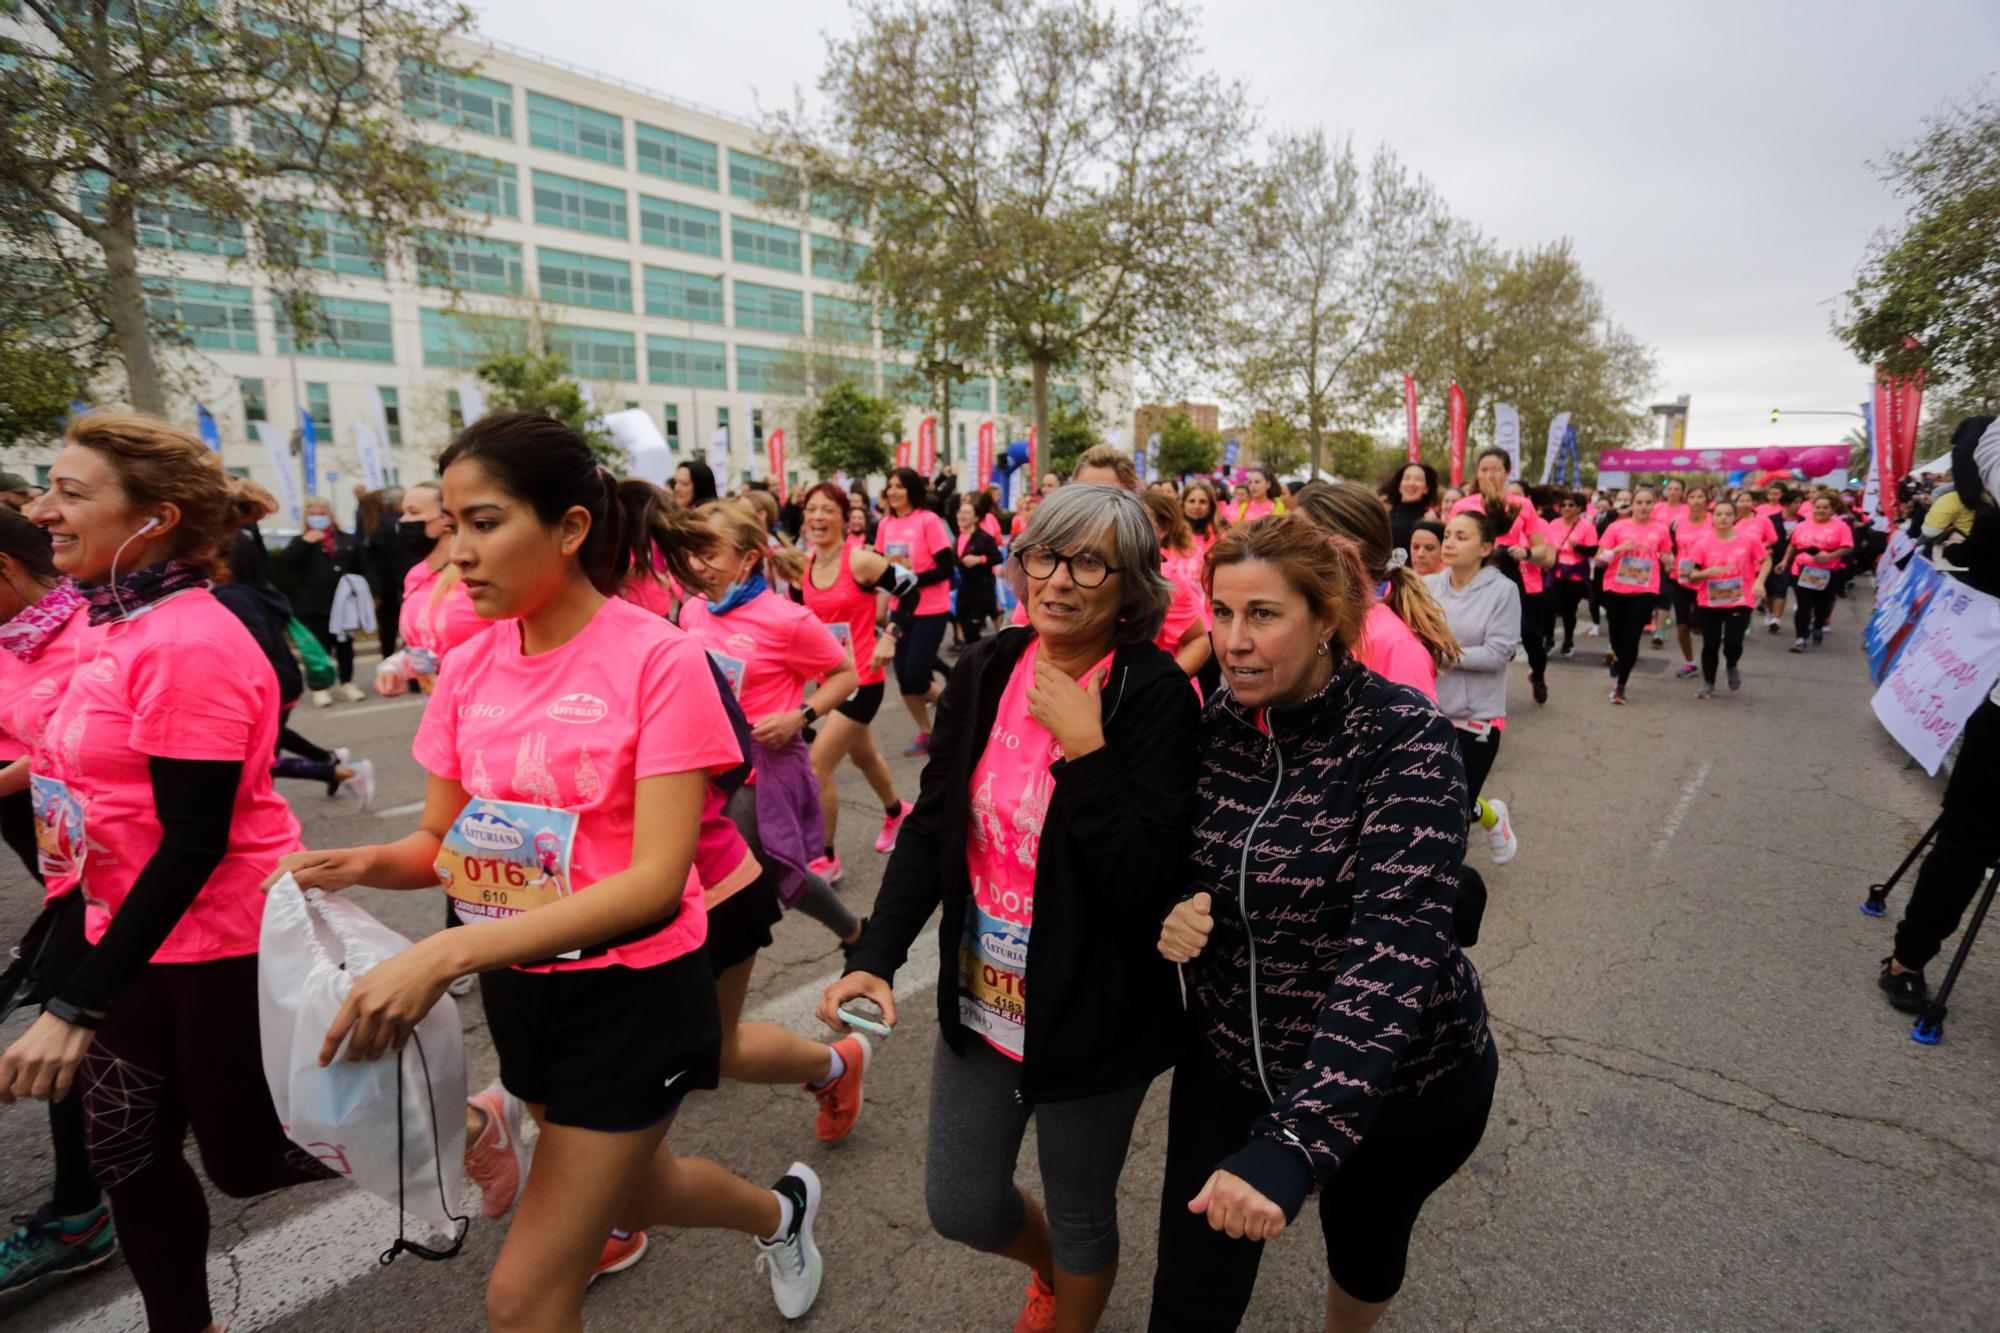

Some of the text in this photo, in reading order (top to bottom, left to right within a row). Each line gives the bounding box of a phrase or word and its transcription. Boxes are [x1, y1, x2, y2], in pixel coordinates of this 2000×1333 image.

[464, 822, 521, 847] ASTURIANA
[464, 855, 526, 887] 016
[482, 889, 508, 905] 610
